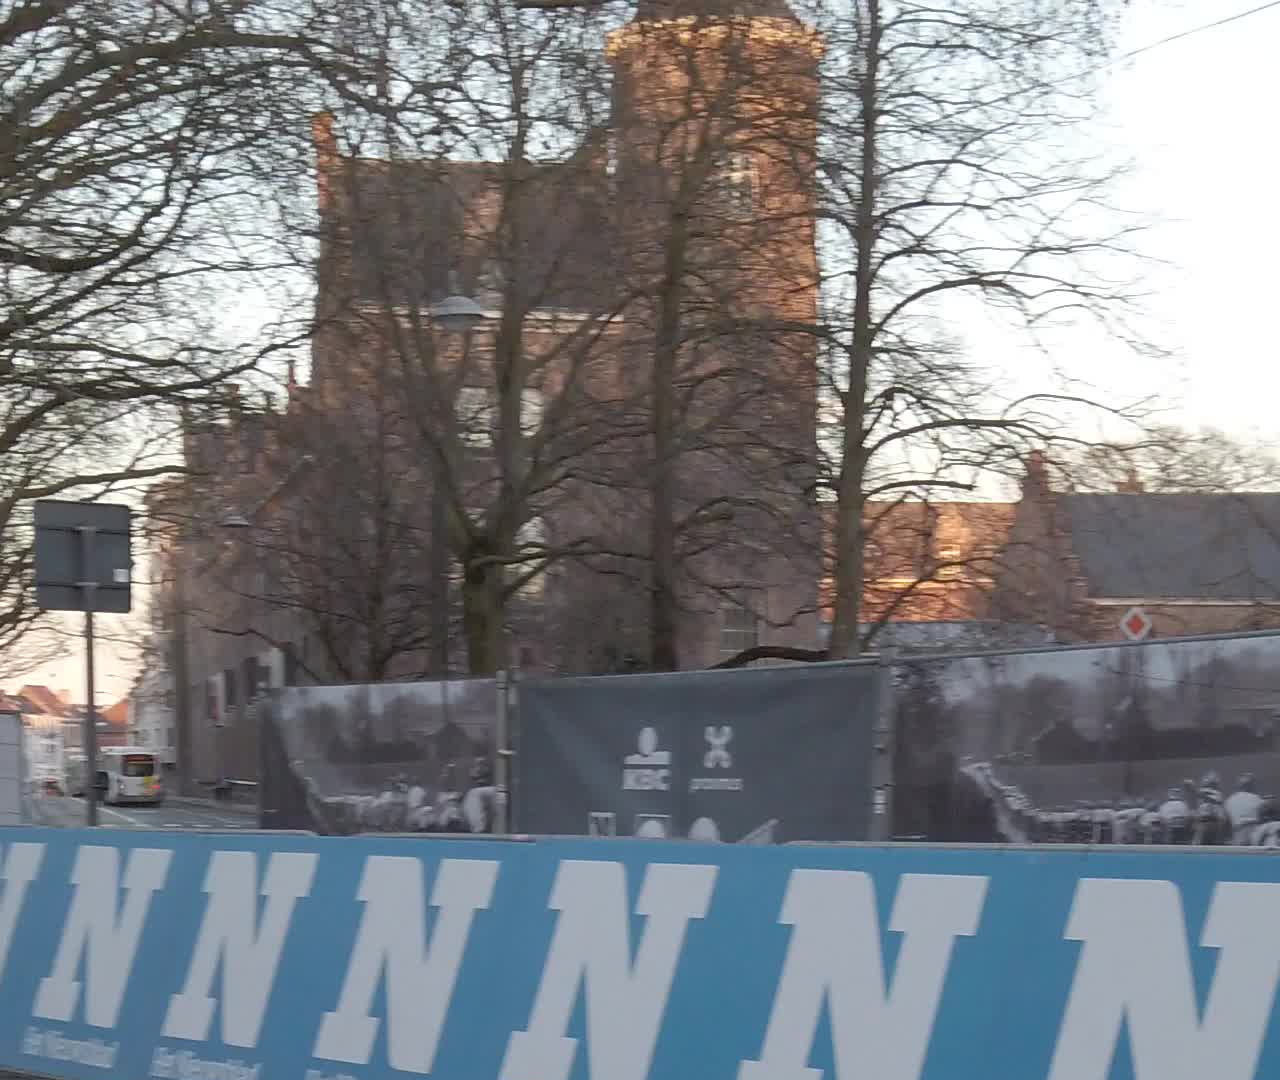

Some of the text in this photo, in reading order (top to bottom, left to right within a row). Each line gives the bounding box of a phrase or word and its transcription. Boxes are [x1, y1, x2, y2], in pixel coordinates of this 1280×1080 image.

[32, 845, 174, 1028] N
[160, 851, 318, 1048] N
[313, 856, 500, 1073] N
